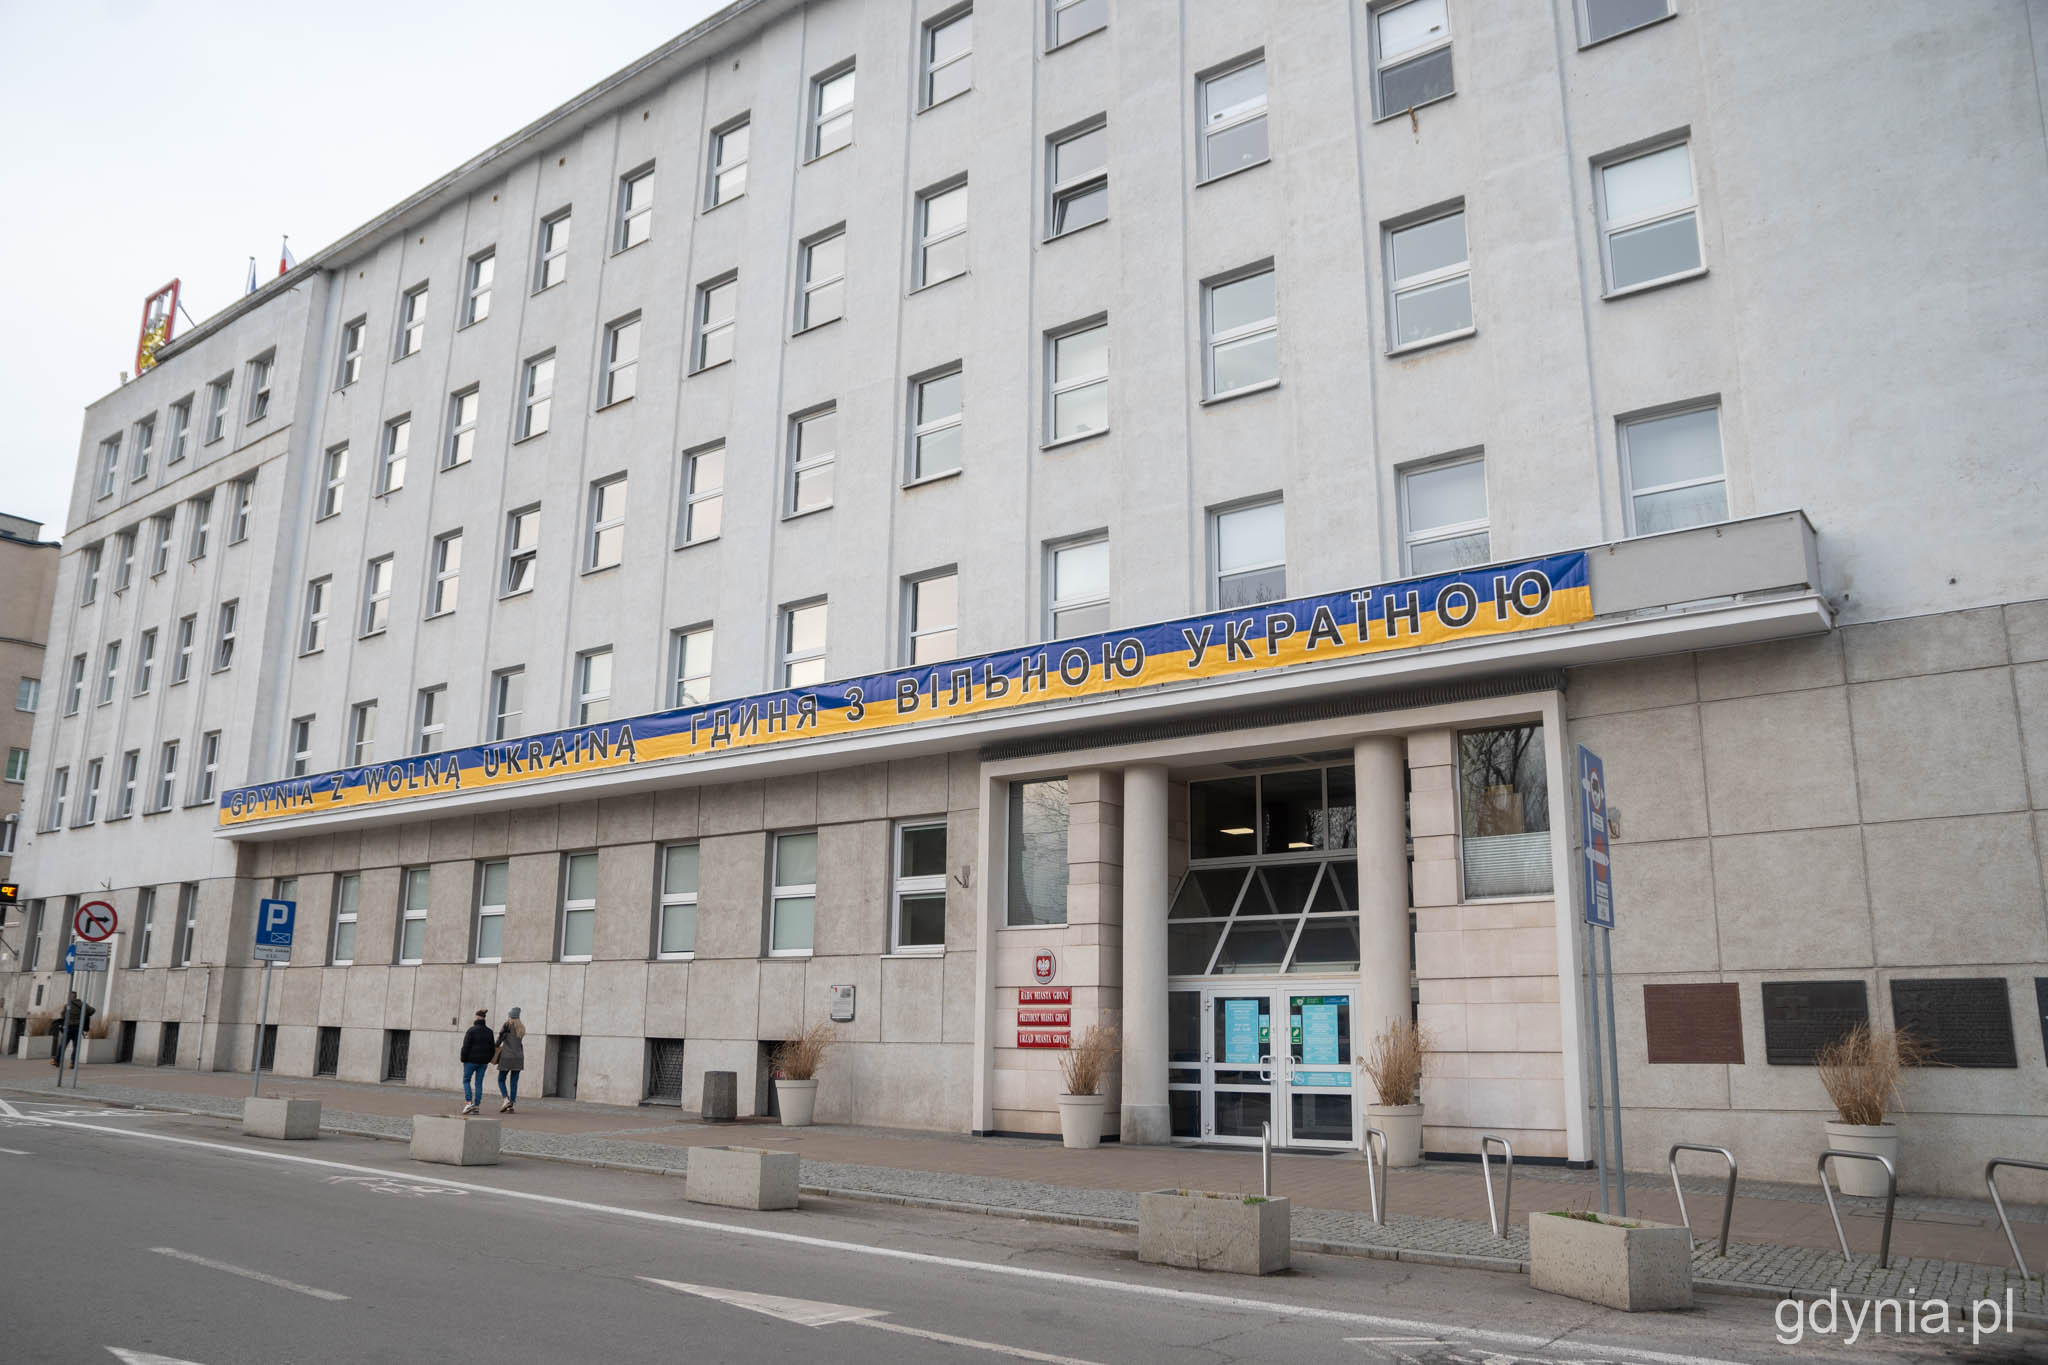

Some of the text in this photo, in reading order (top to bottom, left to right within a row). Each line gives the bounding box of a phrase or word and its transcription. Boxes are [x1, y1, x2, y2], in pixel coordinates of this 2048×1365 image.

[845, 686, 866, 722] З
[895, 637, 1146, 715] ВІЛЬНОЮ
[1182, 568, 1553, 669] УКРАЇНОЮ
[230, 725, 636, 818] GDYNIA Z WOLNĄ UKRAINĄ
[266, 903, 289, 932] P
